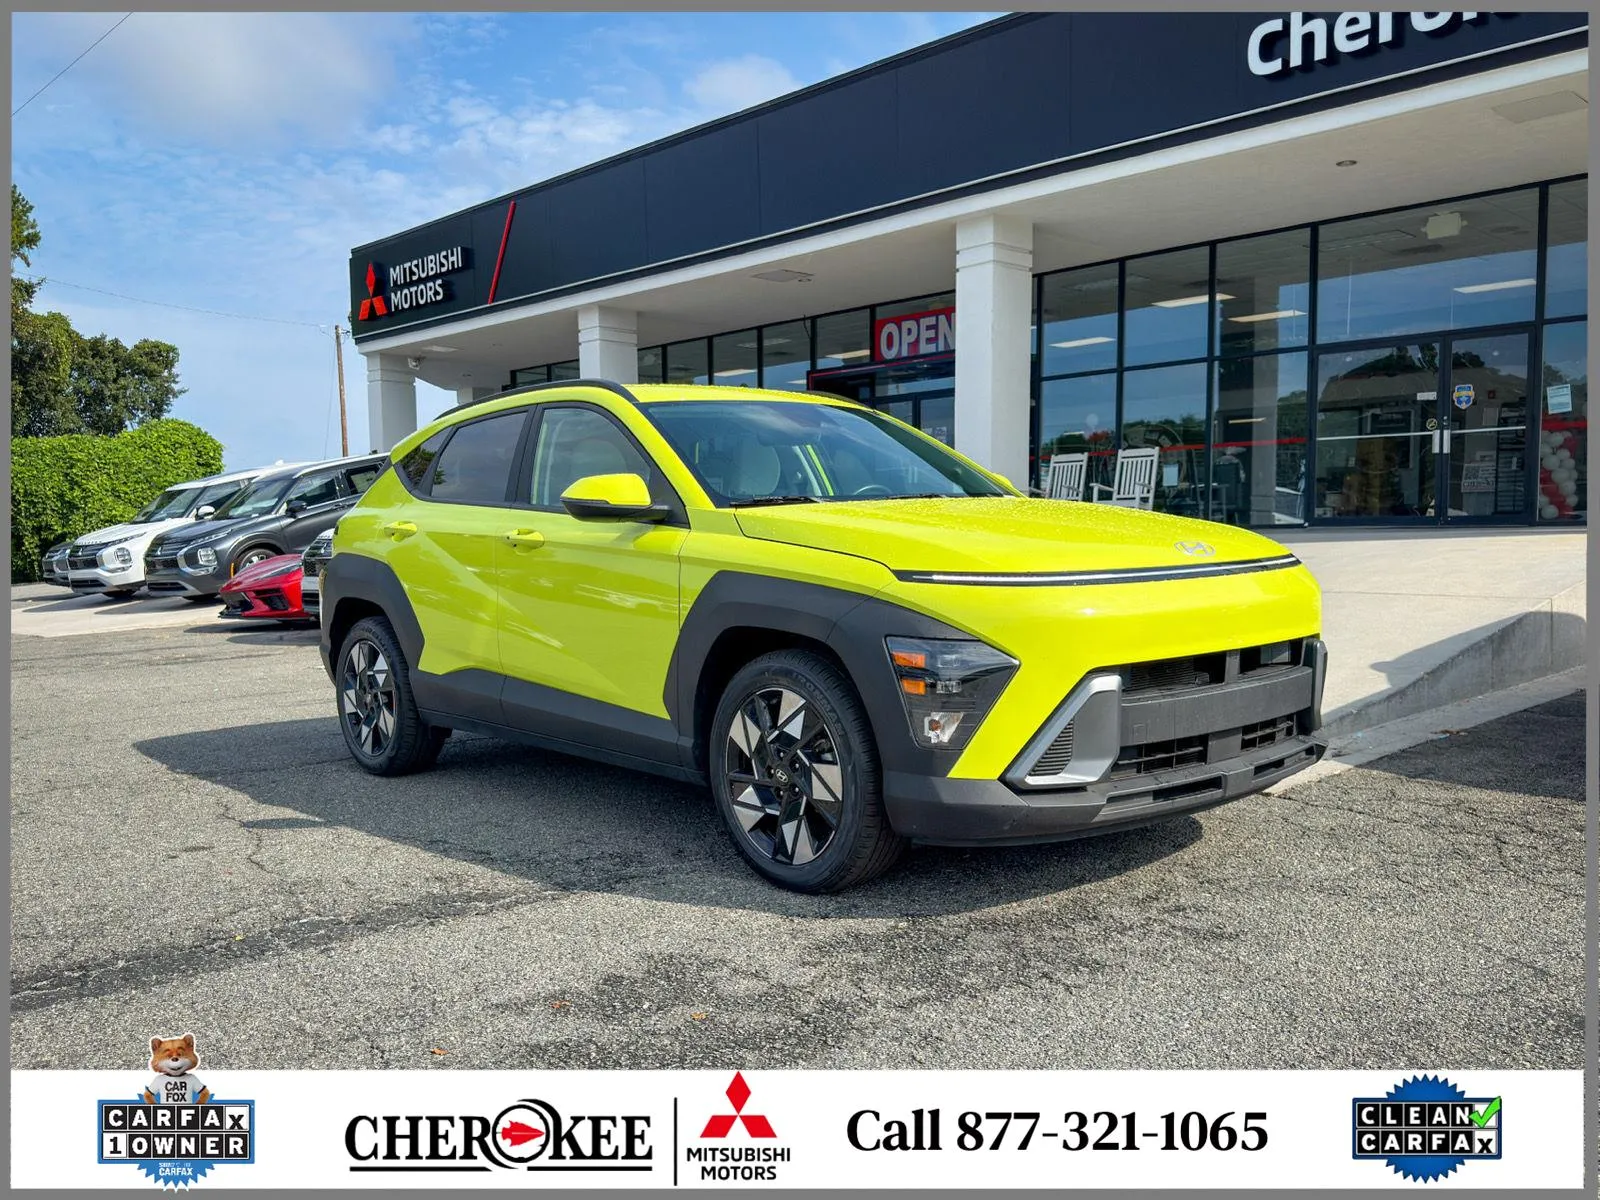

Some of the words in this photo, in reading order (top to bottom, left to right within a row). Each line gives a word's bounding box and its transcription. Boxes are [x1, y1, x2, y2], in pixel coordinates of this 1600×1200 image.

[389, 246, 462, 287] MITSUBISHI
[391, 279, 444, 312] MOTORS
[880, 314, 956, 360] OPEN
